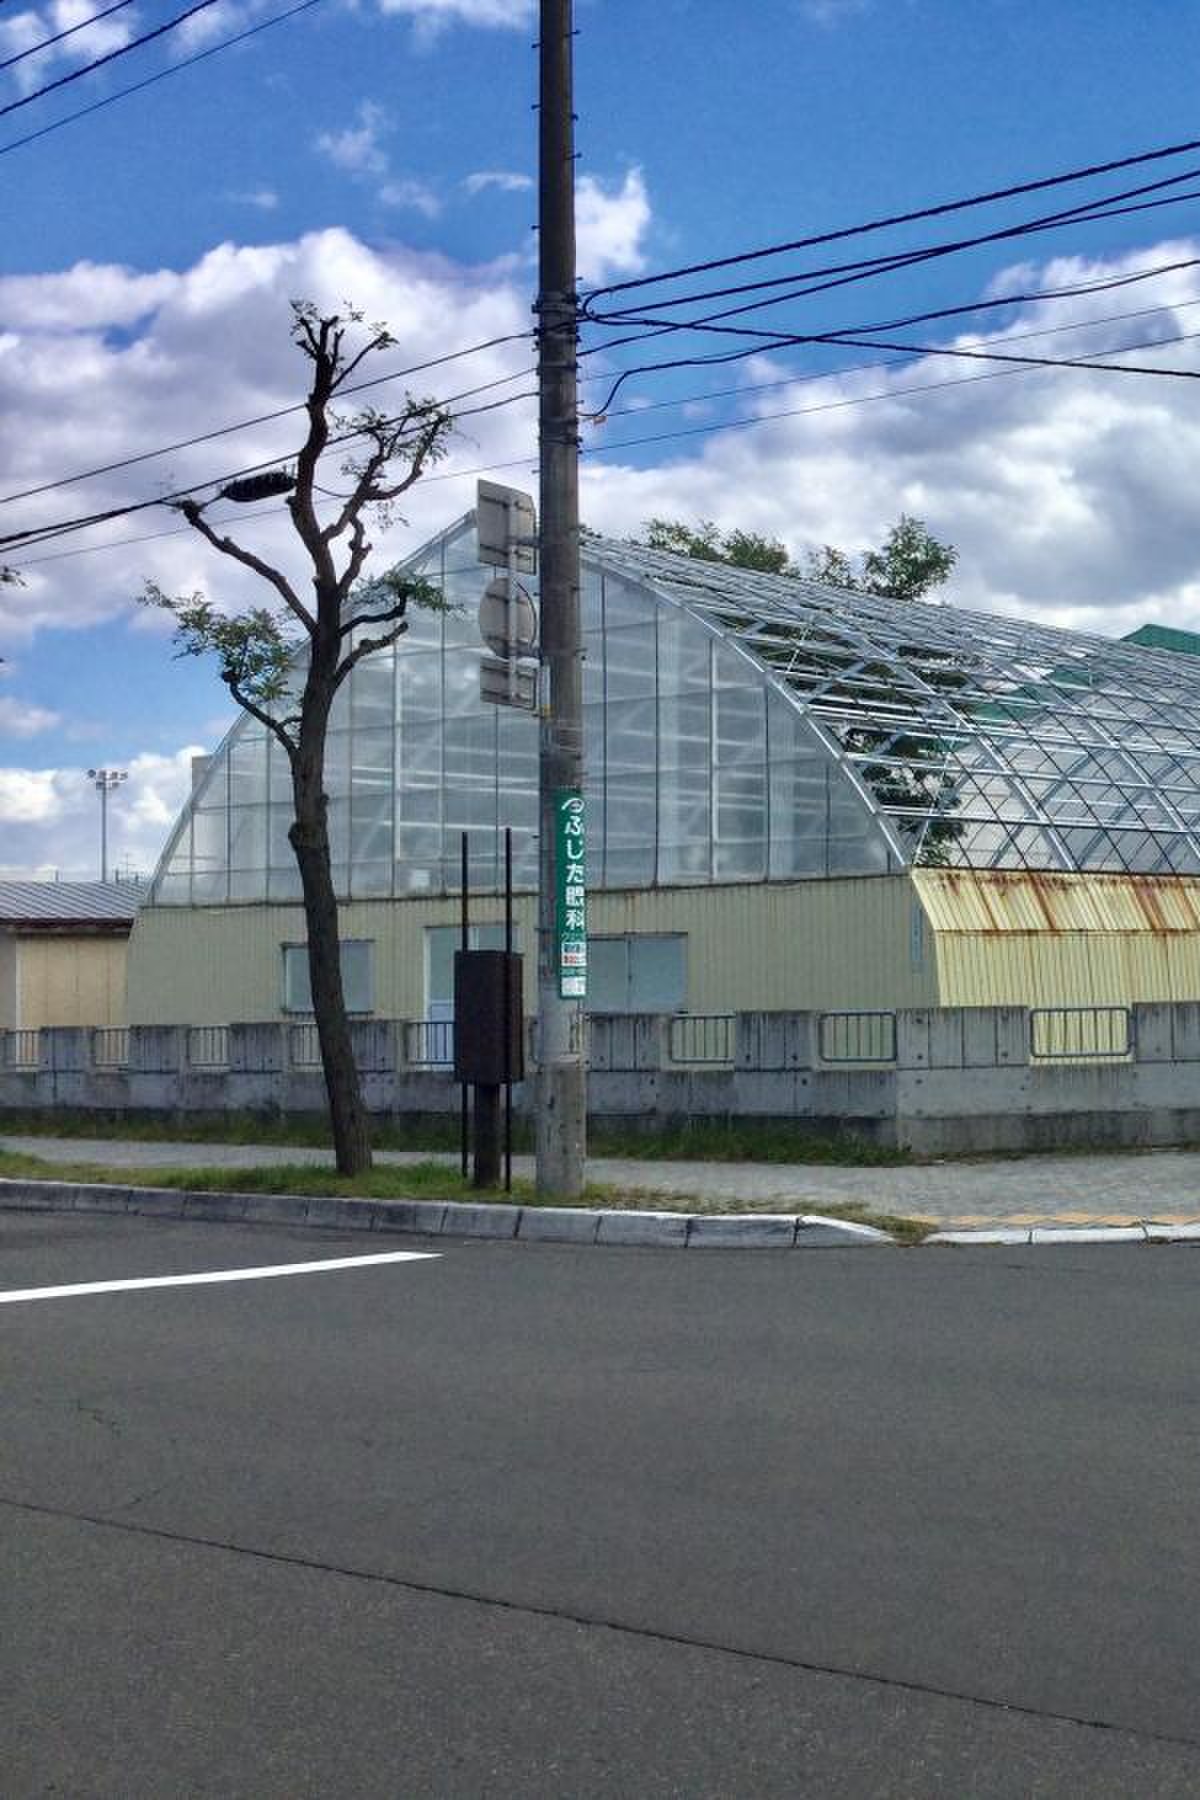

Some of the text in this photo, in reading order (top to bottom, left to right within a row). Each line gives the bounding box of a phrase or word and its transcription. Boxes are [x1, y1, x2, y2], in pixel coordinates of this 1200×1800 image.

[564, 816, 585, 930] ふじた眼科
